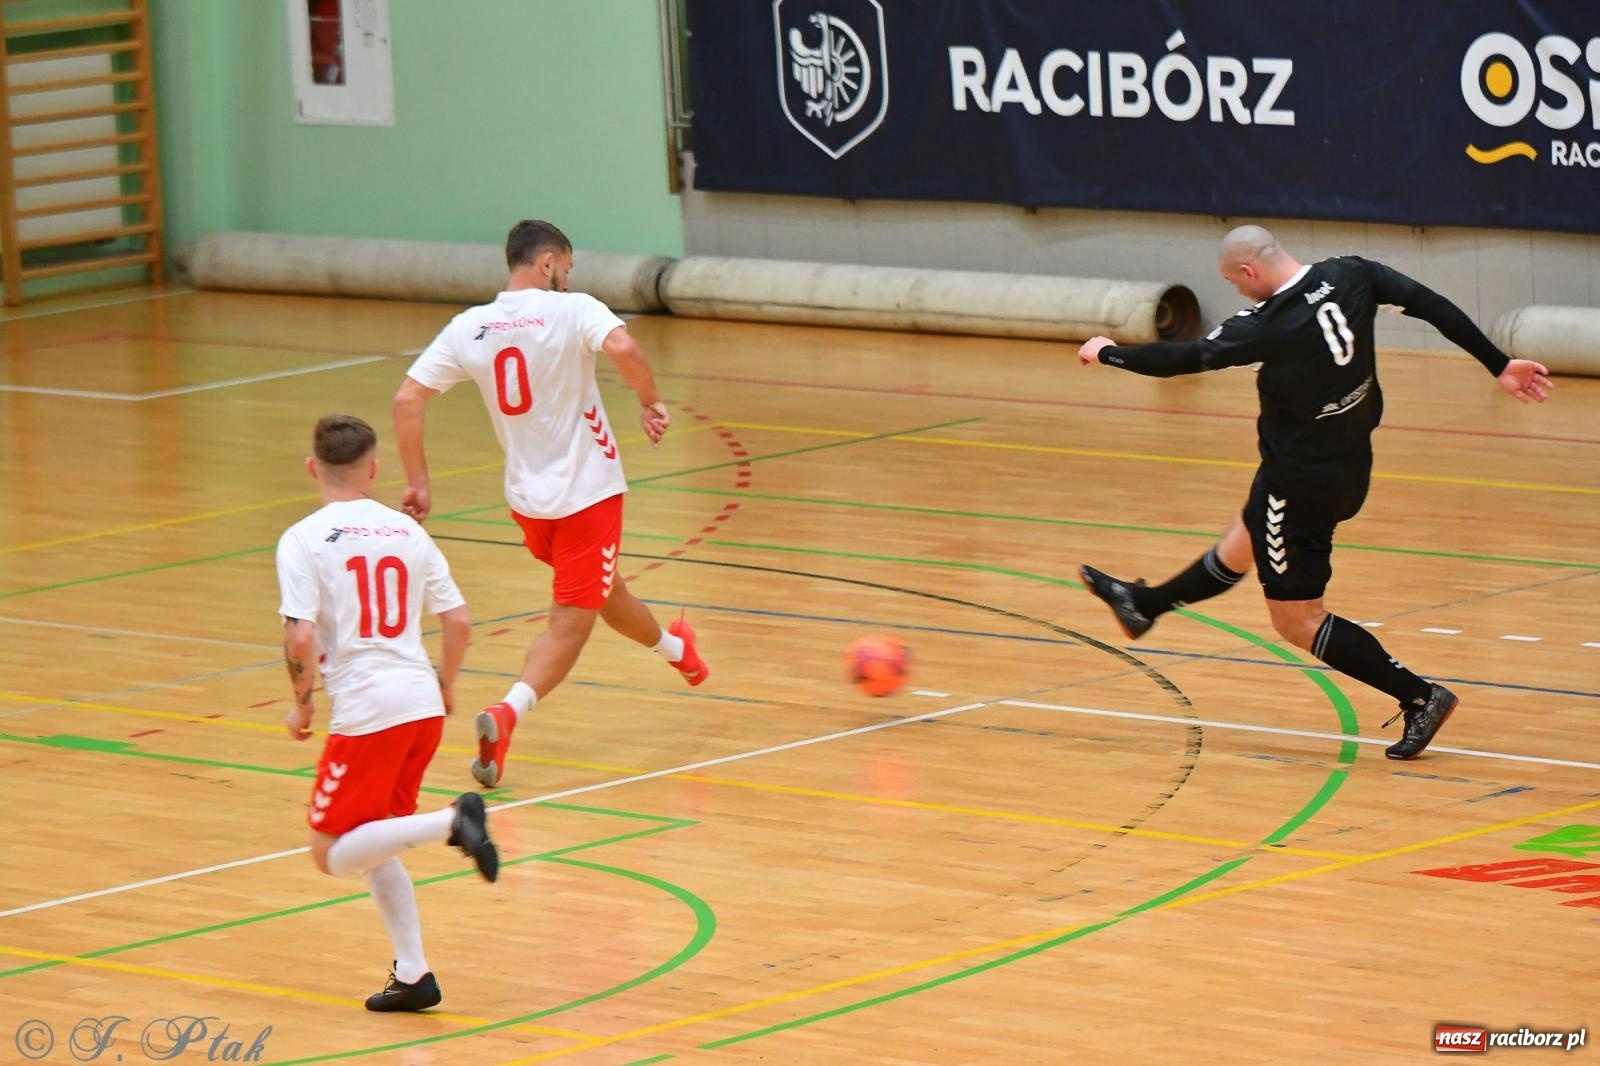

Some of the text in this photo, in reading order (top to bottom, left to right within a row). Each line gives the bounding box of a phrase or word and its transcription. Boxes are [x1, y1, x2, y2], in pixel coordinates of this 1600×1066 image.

[948, 30, 1295, 126] RACIBÓRZ
[1316, 302, 1355, 366] 0
[494, 347, 533, 416] 0
[345, 556, 408, 639] 10
